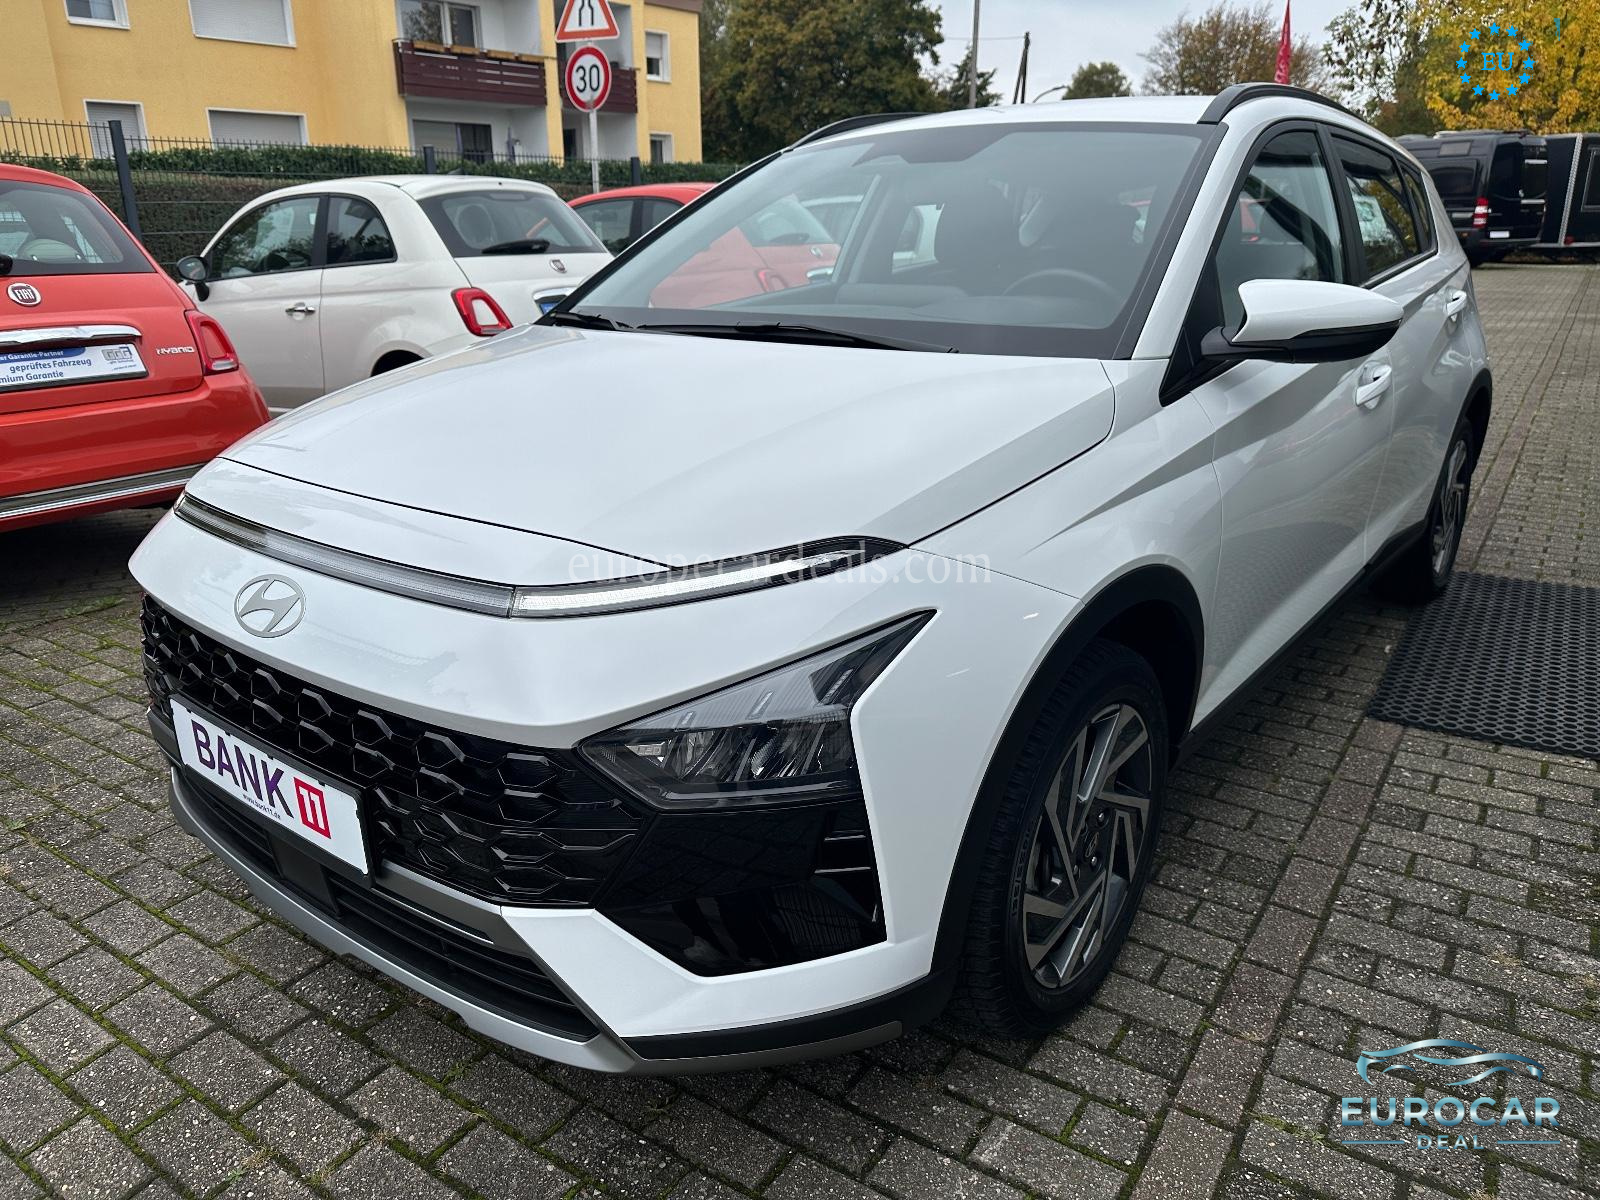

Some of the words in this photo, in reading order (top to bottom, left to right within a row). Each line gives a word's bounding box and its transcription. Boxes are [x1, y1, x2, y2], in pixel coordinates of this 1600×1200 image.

[575, 64, 600, 93] 30
[14, 288, 35, 300] FIAT
[9, 361, 52, 374] geprüftes
[53, 358, 92, 368] Fahrzeug
[26, 370, 64, 381] Garantie
[191, 719, 295, 819] BANK
